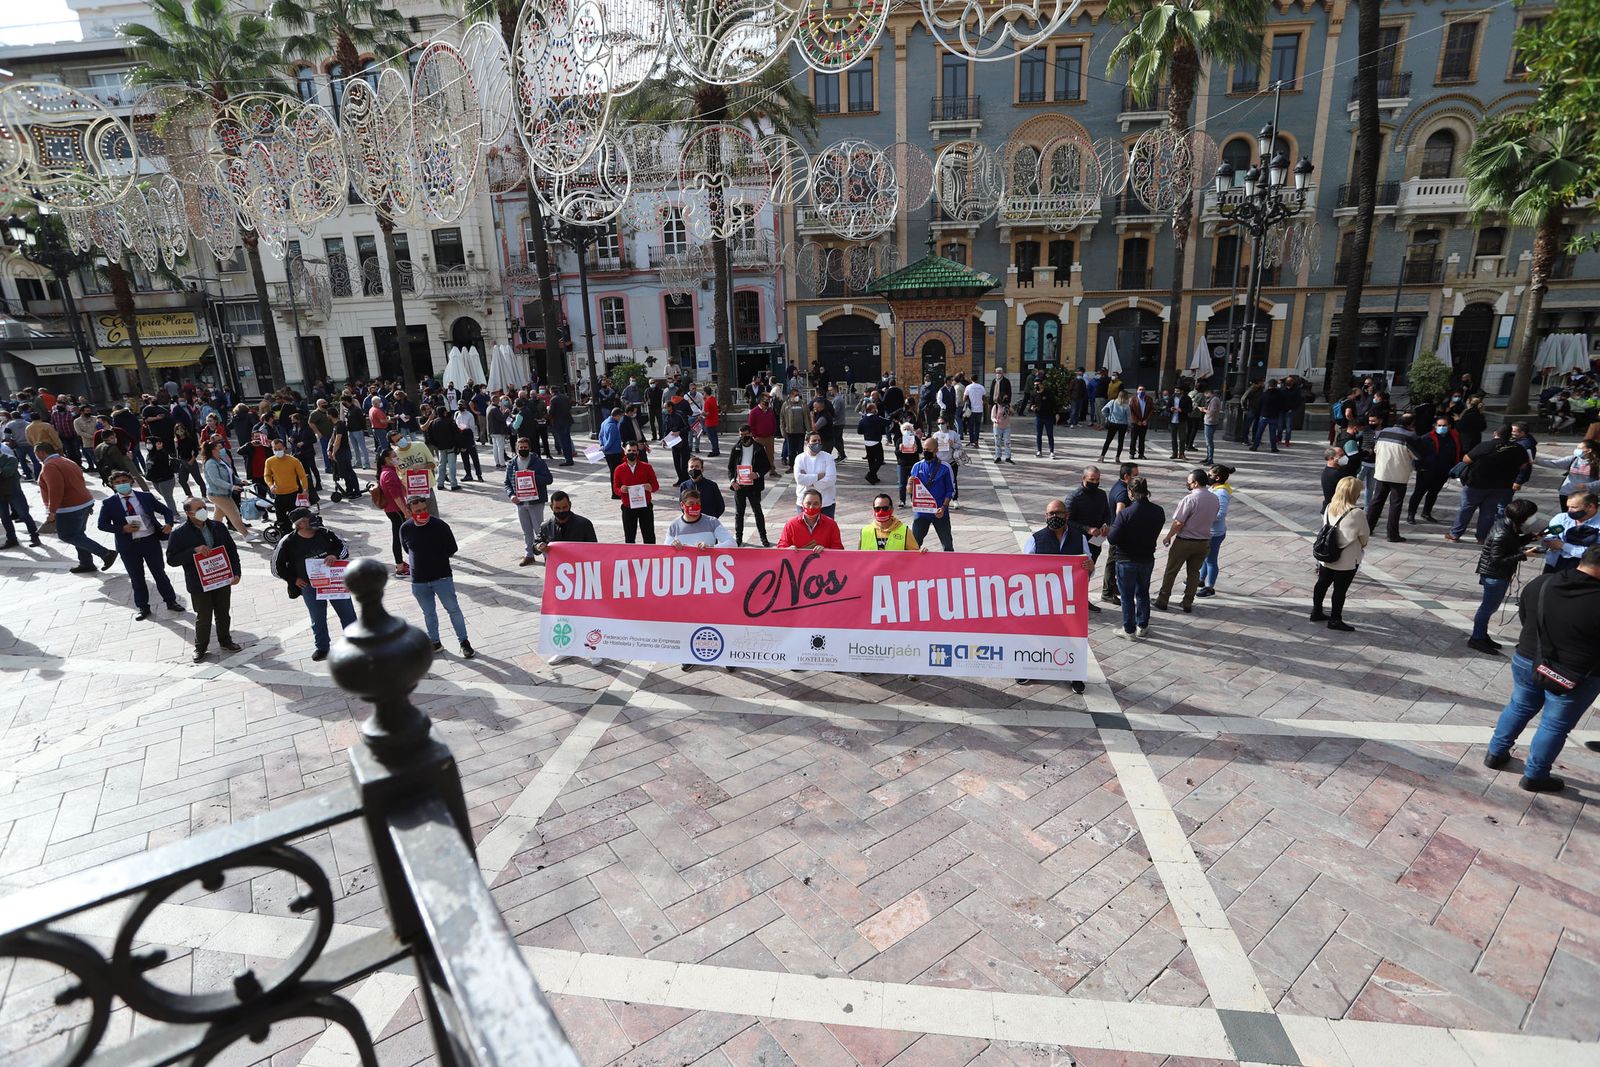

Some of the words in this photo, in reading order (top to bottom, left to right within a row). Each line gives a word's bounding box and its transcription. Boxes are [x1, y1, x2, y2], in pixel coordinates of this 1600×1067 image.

[555, 561, 603, 601] SIN
[612, 554, 735, 599] AYUDAS
[743, 553, 848, 618] Nos
[871, 565, 1076, 624] Arruinan!
[603, 633, 629, 641] Federación
[629, 635, 651, 643] Provincial
[658, 637, 681, 645] Empresas
[848, 642, 921, 659] Hosturjaén
[729, 650, 786, 661] HOSTECOR
